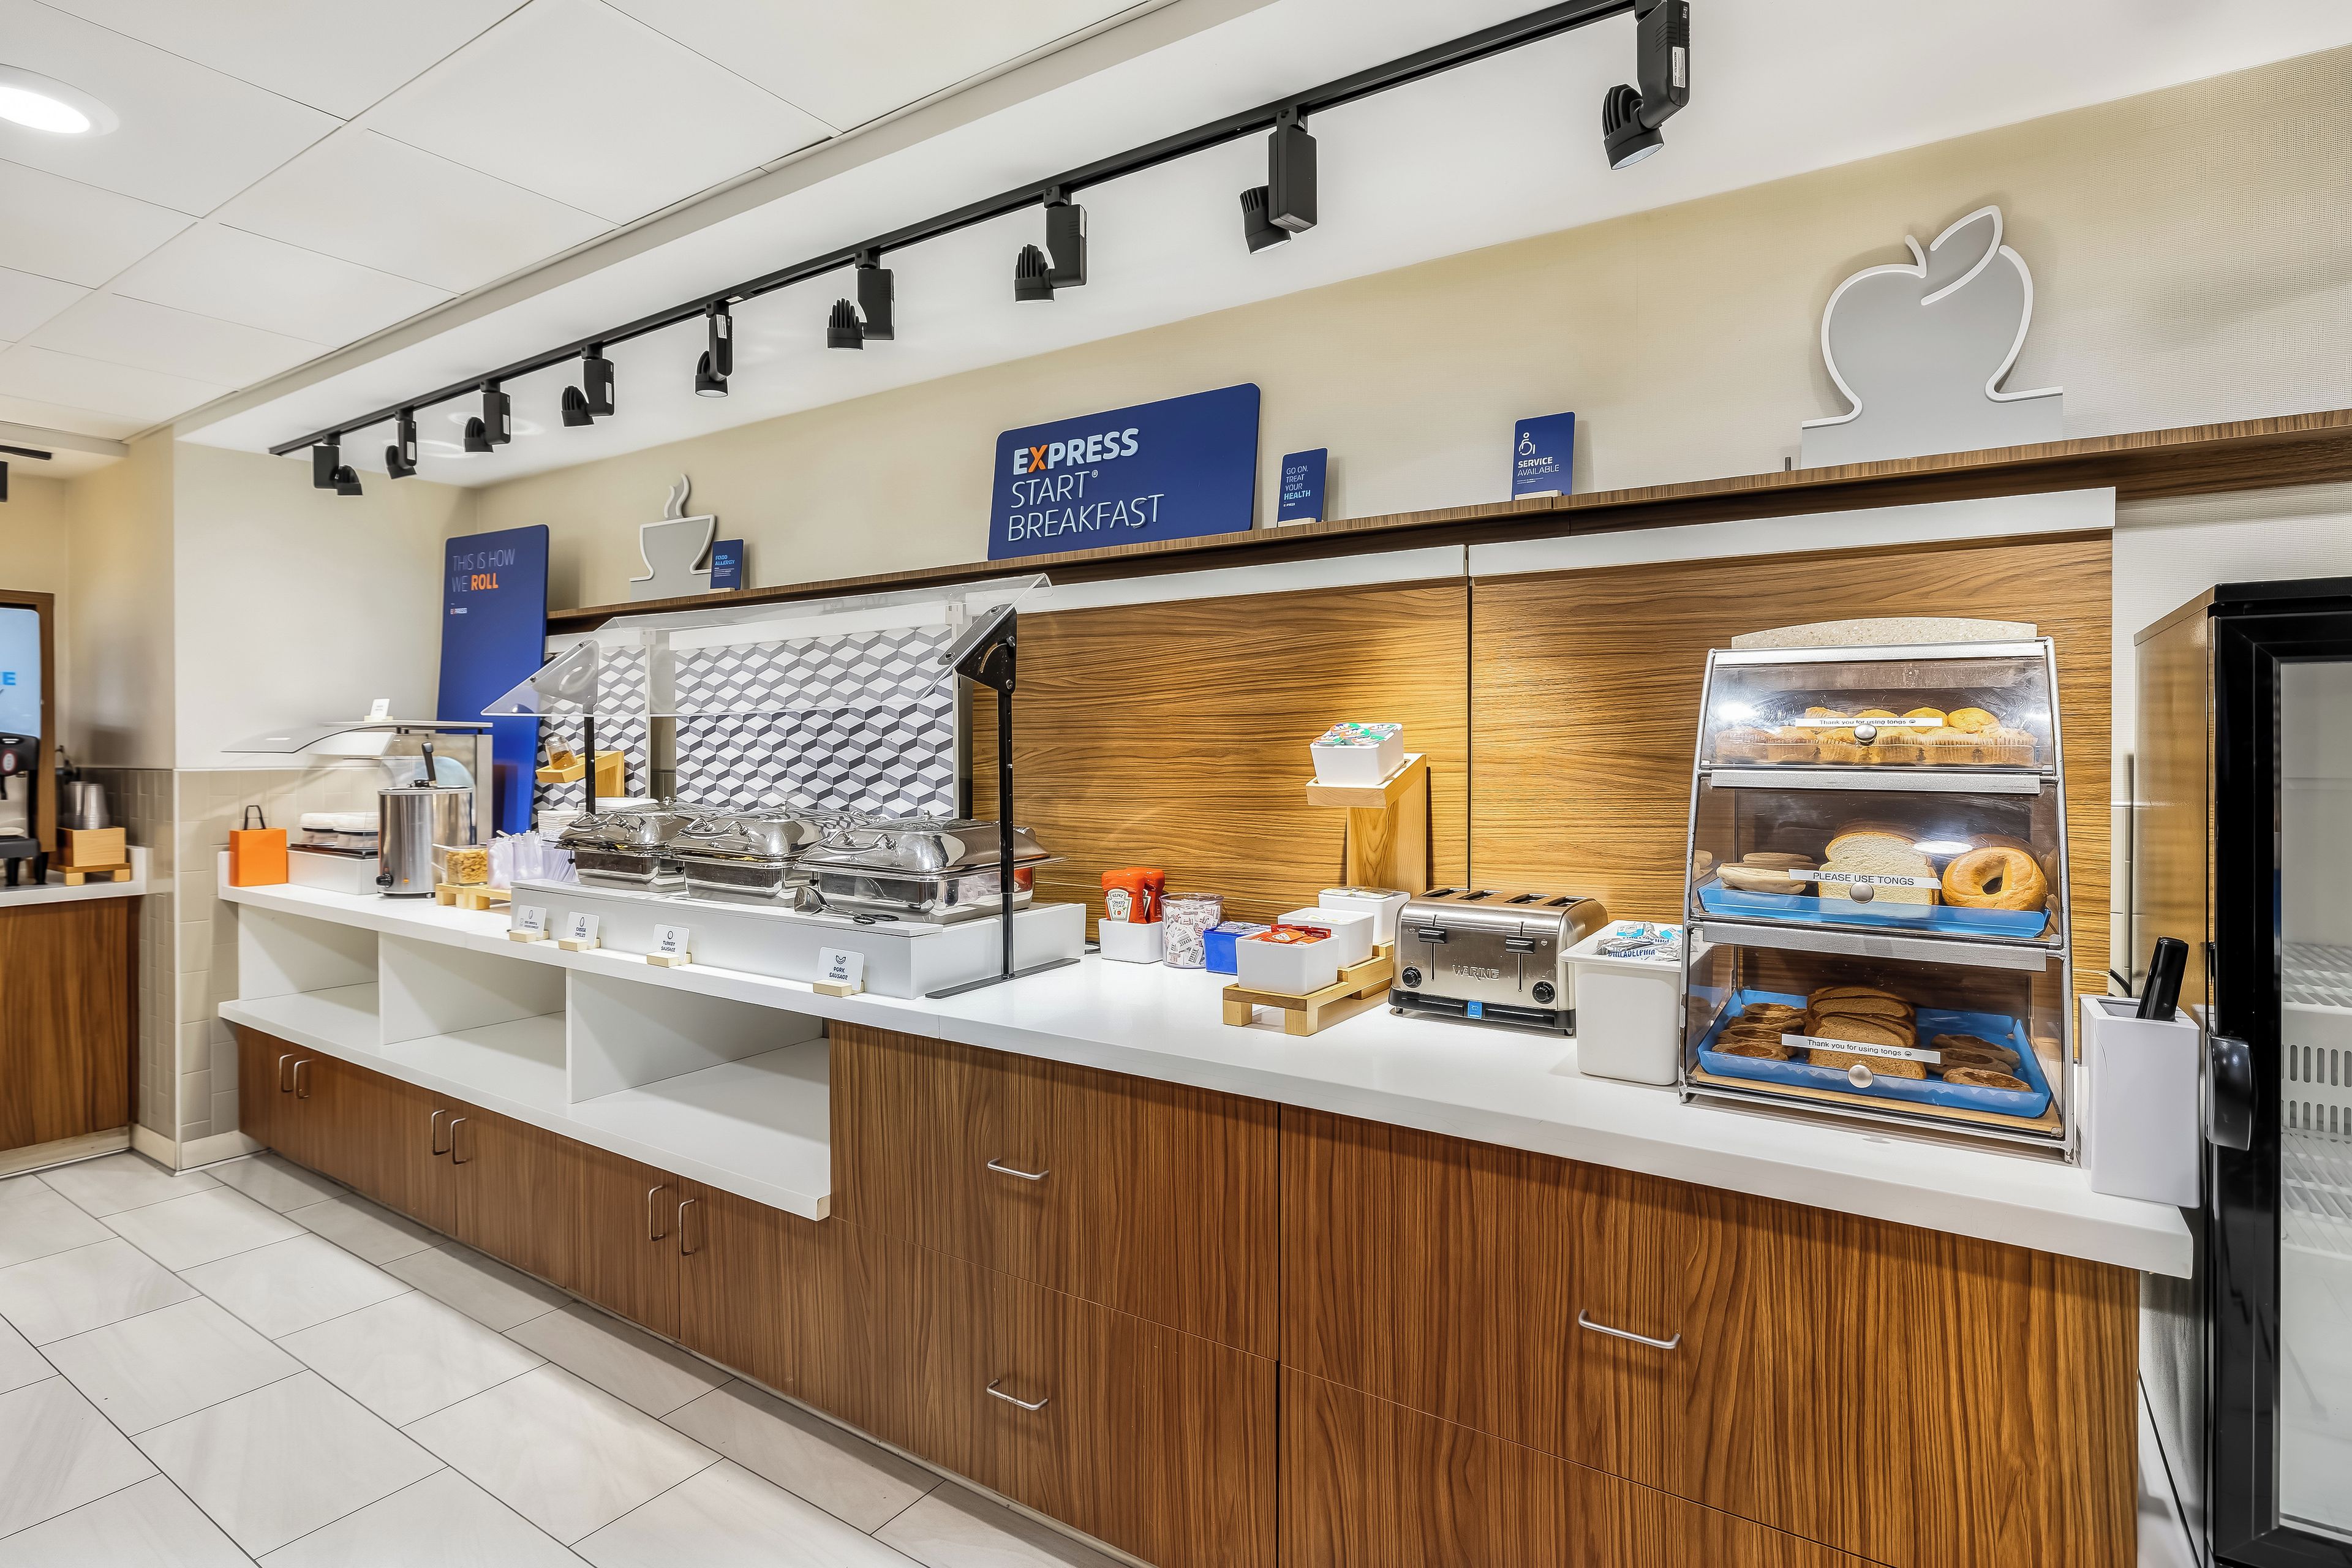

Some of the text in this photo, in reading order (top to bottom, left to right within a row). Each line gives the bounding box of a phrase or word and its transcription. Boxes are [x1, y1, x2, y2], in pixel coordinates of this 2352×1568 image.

[1013, 428, 1139, 475] EXPRESS
[1297, 465, 1308, 473] ON.
[1518, 456, 1553, 469] SERVICE
[1517, 464, 1559, 477] AVAILABLE
[1286, 474, 1305, 483] TREAT
[1285, 483, 1303, 491] YOUR
[1284, 489, 1311, 500] HEALTH
[1008, 494, 1165, 542] BREAKFAST
[453, 548, 515, 571] THIS IS HOW
[451, 572, 499, 592] WE ROLL
[1813, 872, 1915, 886] PLEASE USE TONGS
[1807, 1039, 1830, 1047] Thank
[1858, 1046, 1879, 1054] using
[1881, 1047, 1902, 1056] tongs
